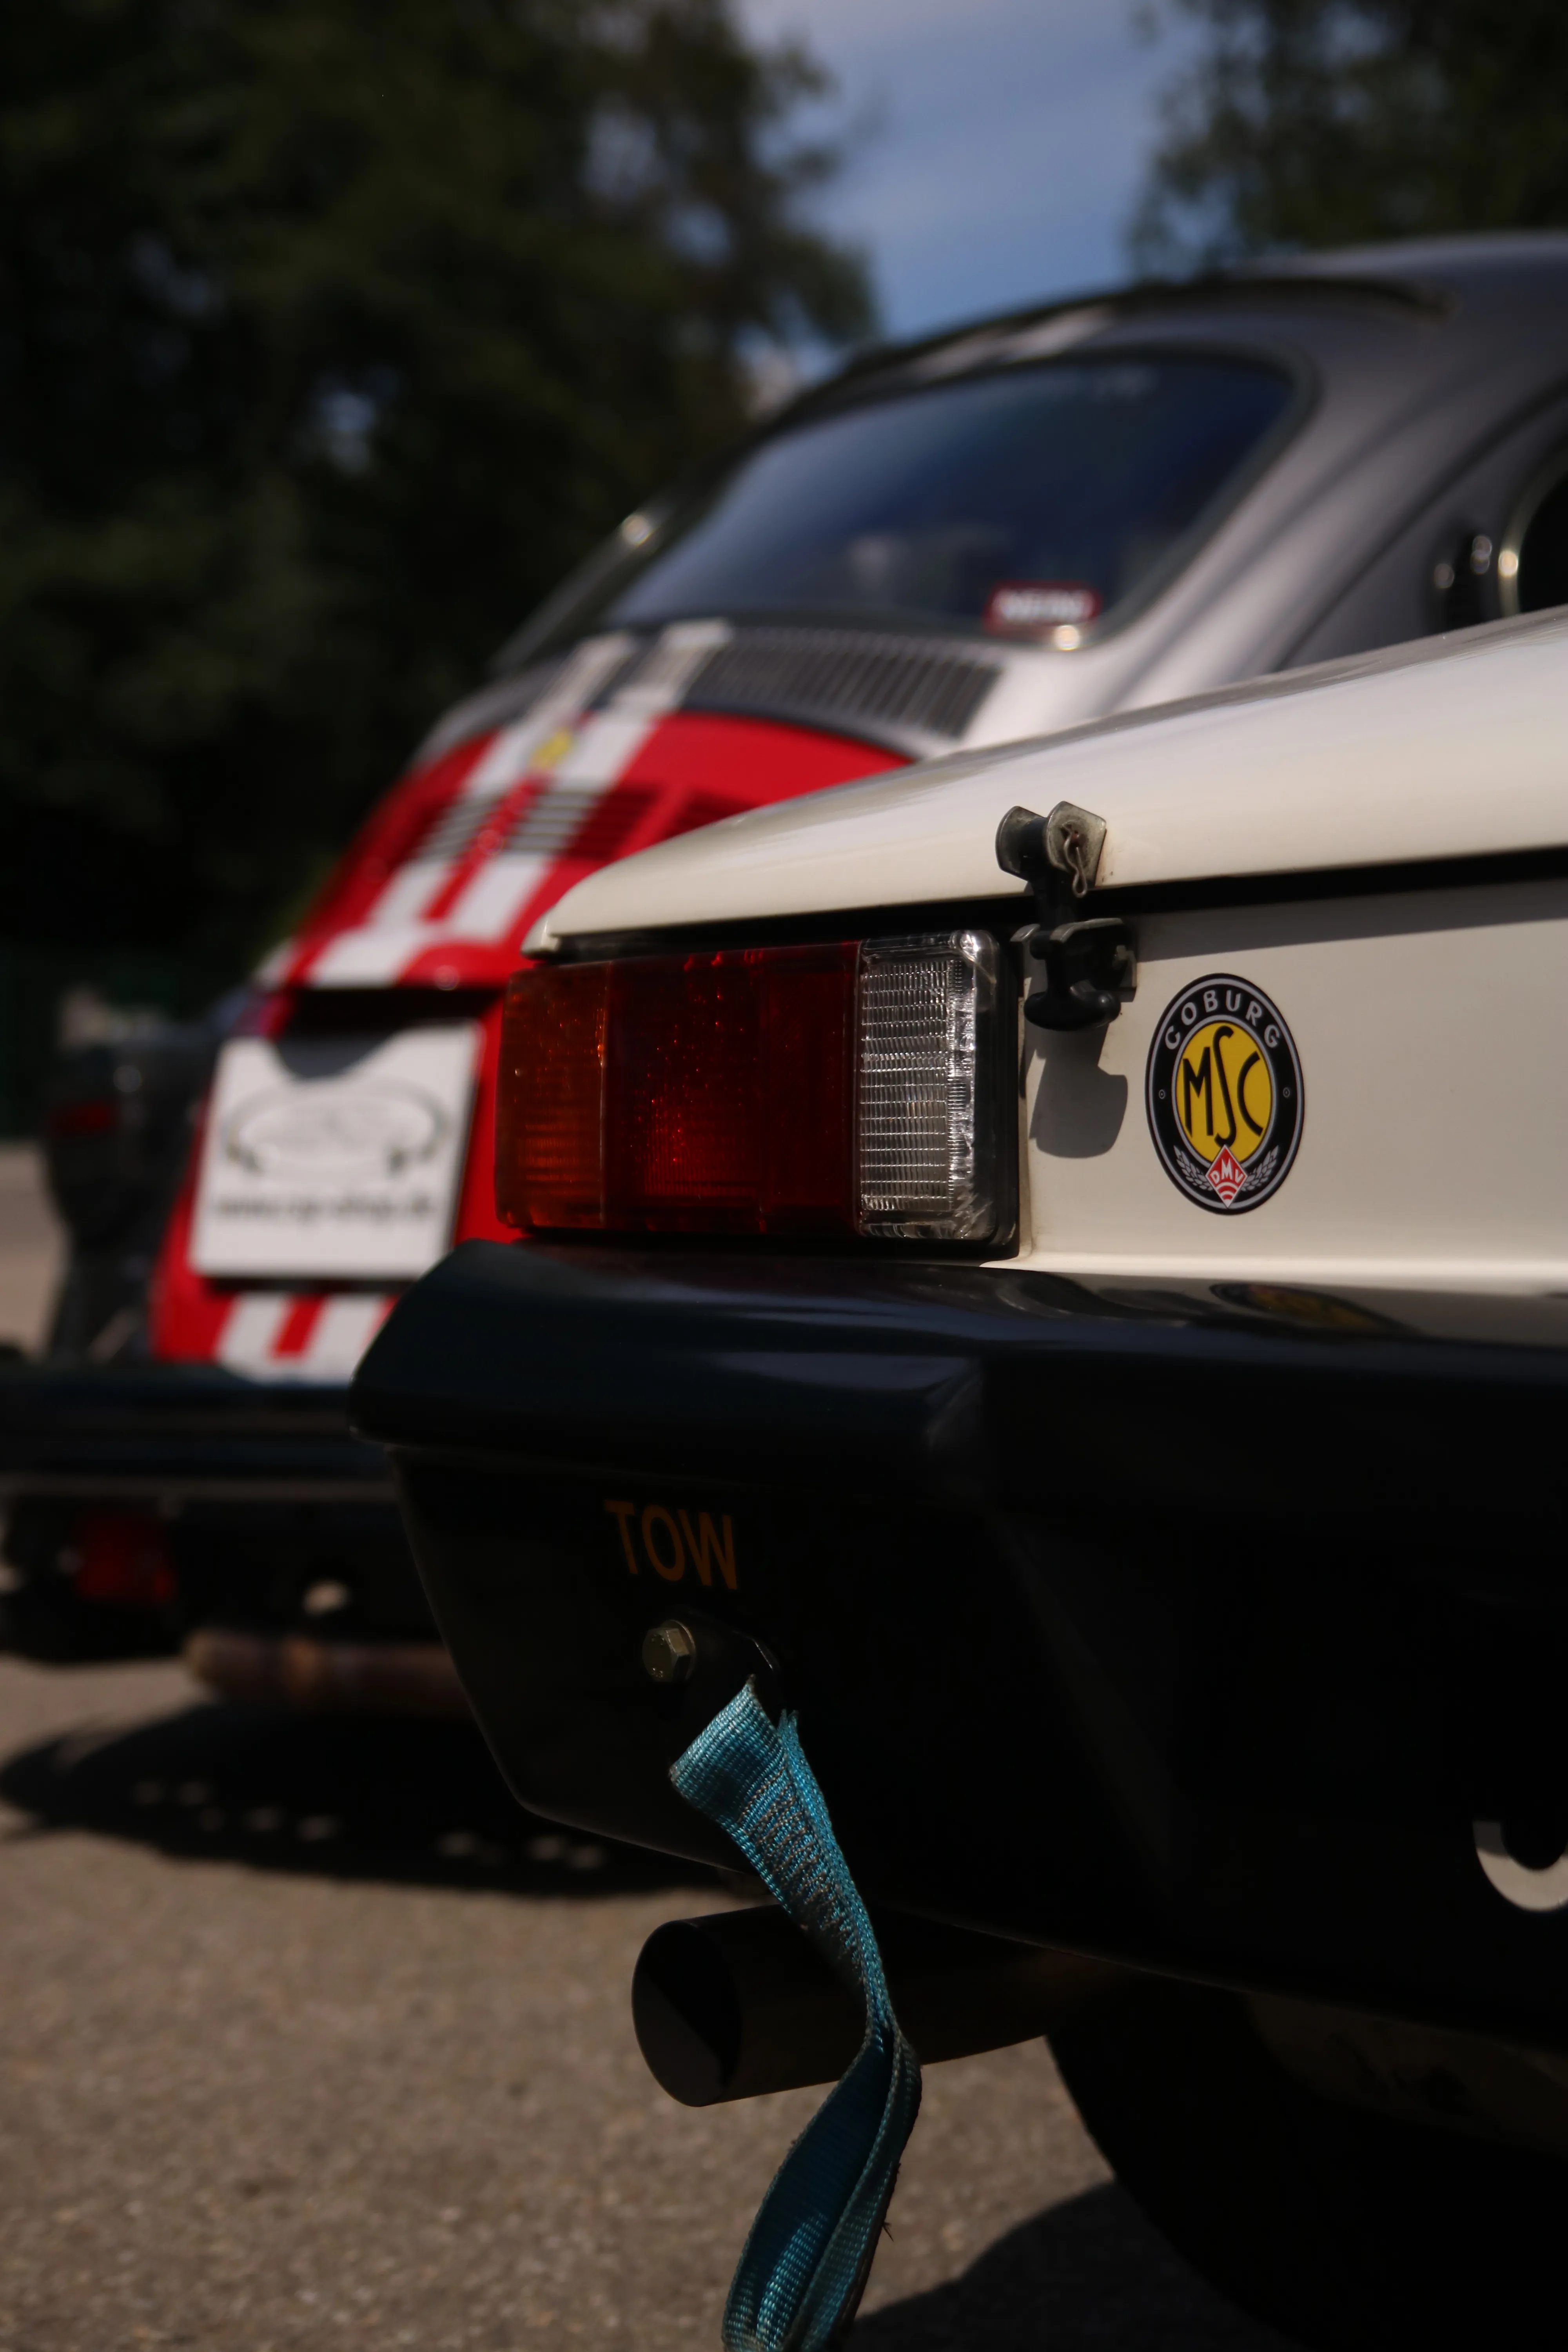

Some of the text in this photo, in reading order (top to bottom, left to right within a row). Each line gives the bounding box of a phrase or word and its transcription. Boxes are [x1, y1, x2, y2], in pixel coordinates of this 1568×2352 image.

[1165, 990, 1280, 1049] COBURG
[1183, 1025, 1263, 1147] MSC
[1210, 1158, 1243, 1184] DMV
[604, 1499, 737, 1590] TOW
